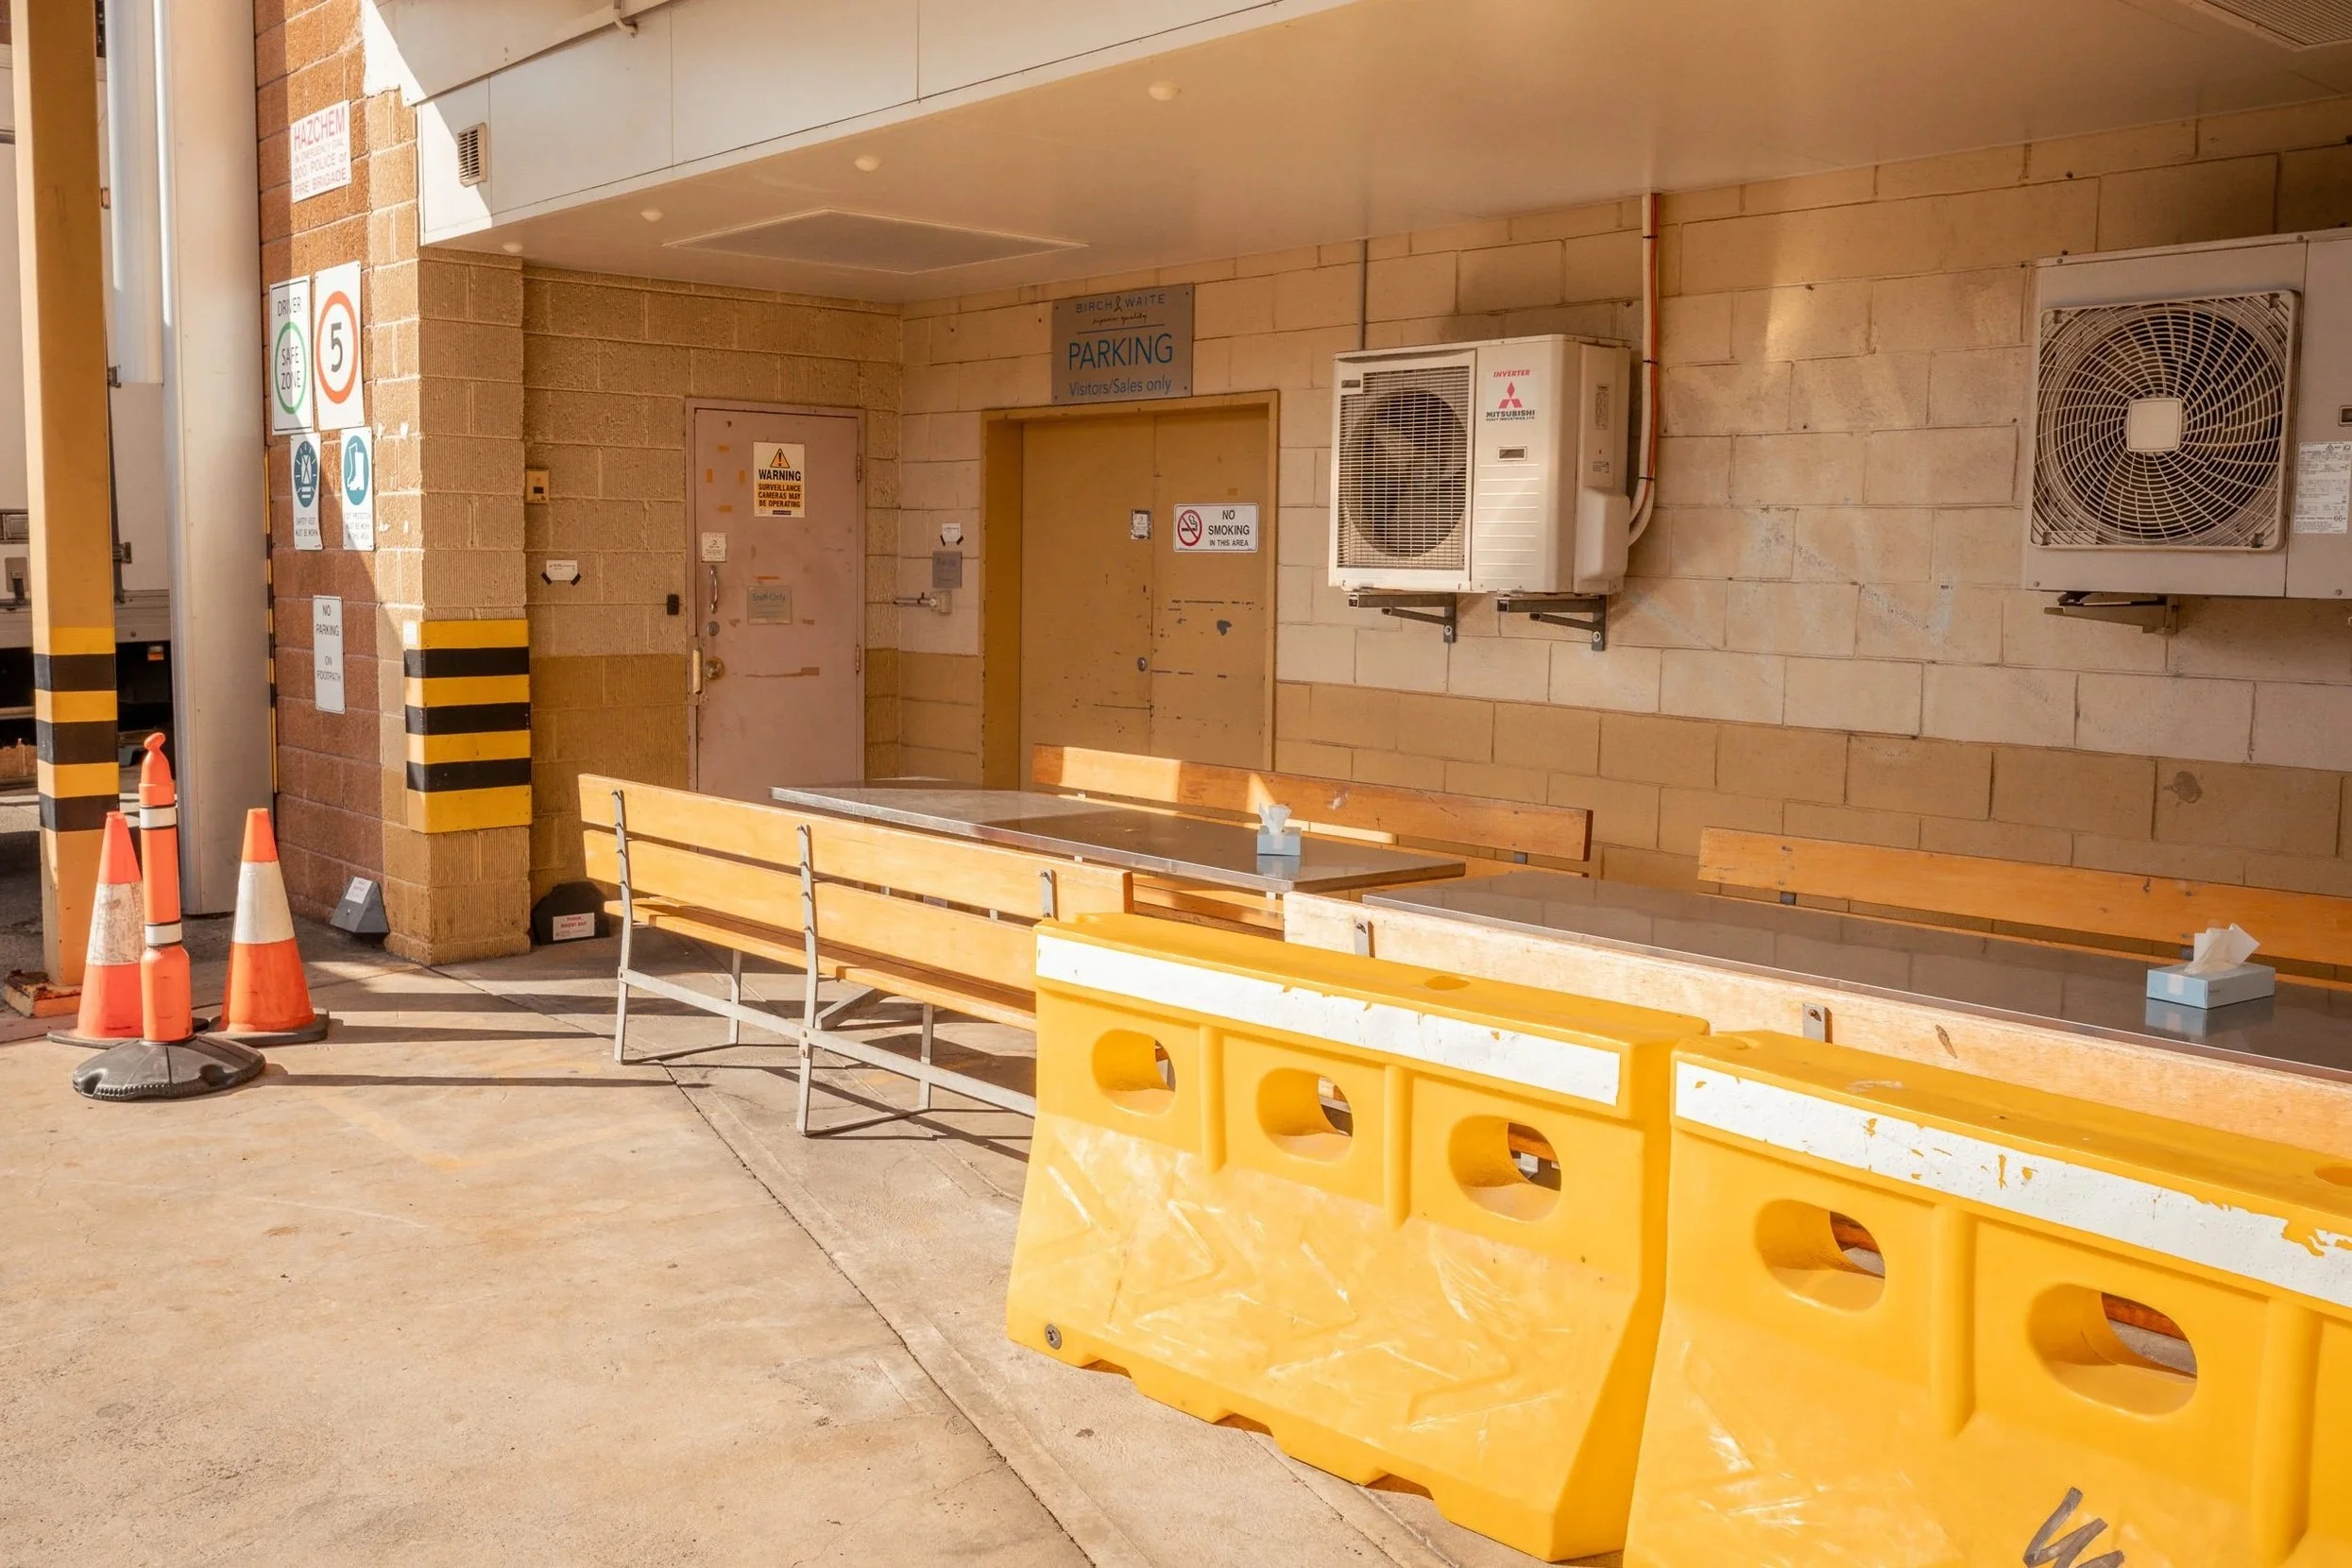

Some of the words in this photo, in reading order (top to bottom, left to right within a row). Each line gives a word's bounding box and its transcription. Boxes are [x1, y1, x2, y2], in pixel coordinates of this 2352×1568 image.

[294, 106, 346, 152] HAZCHEM
[310, 153, 336, 172] POLICE
[313, 167, 347, 190] BRIGADE
[277, 296, 301, 316] DRIVER
[1076, 301, 1113, 313] BIRCH
[1125, 294, 1166, 308] WAITE
[1120, 312, 1148, 325] quality
[331, 321, 343, 373] 5
[1068, 332, 1173, 370] PARKING
[281, 345, 299, 366] SAFE
[281, 370, 301, 390] ZONE
[1492, 369, 1530, 378] INVERTER
[1069, 378, 1143, 397] Visitors/Sales
[1146, 374, 1172, 395] only
[1486, 409, 1535, 418] MITSUBISHI
[758, 469, 802, 482] WARNING
[758, 483, 802, 492] SURVEILLANCE
[758, 491, 787, 500] CAMERAS
[758, 499, 767, 507] BE
[768, 499, 801, 508] OPERATING
[1222, 510, 1236, 520] NO
[1208, 524, 1250, 536] SMOKING
[322, 605, 332, 617] NO
[315, 623, 340, 637] PARKING
[324, 655, 332, 666] ON
[316, 670, 341, 681] FOOTPATH
